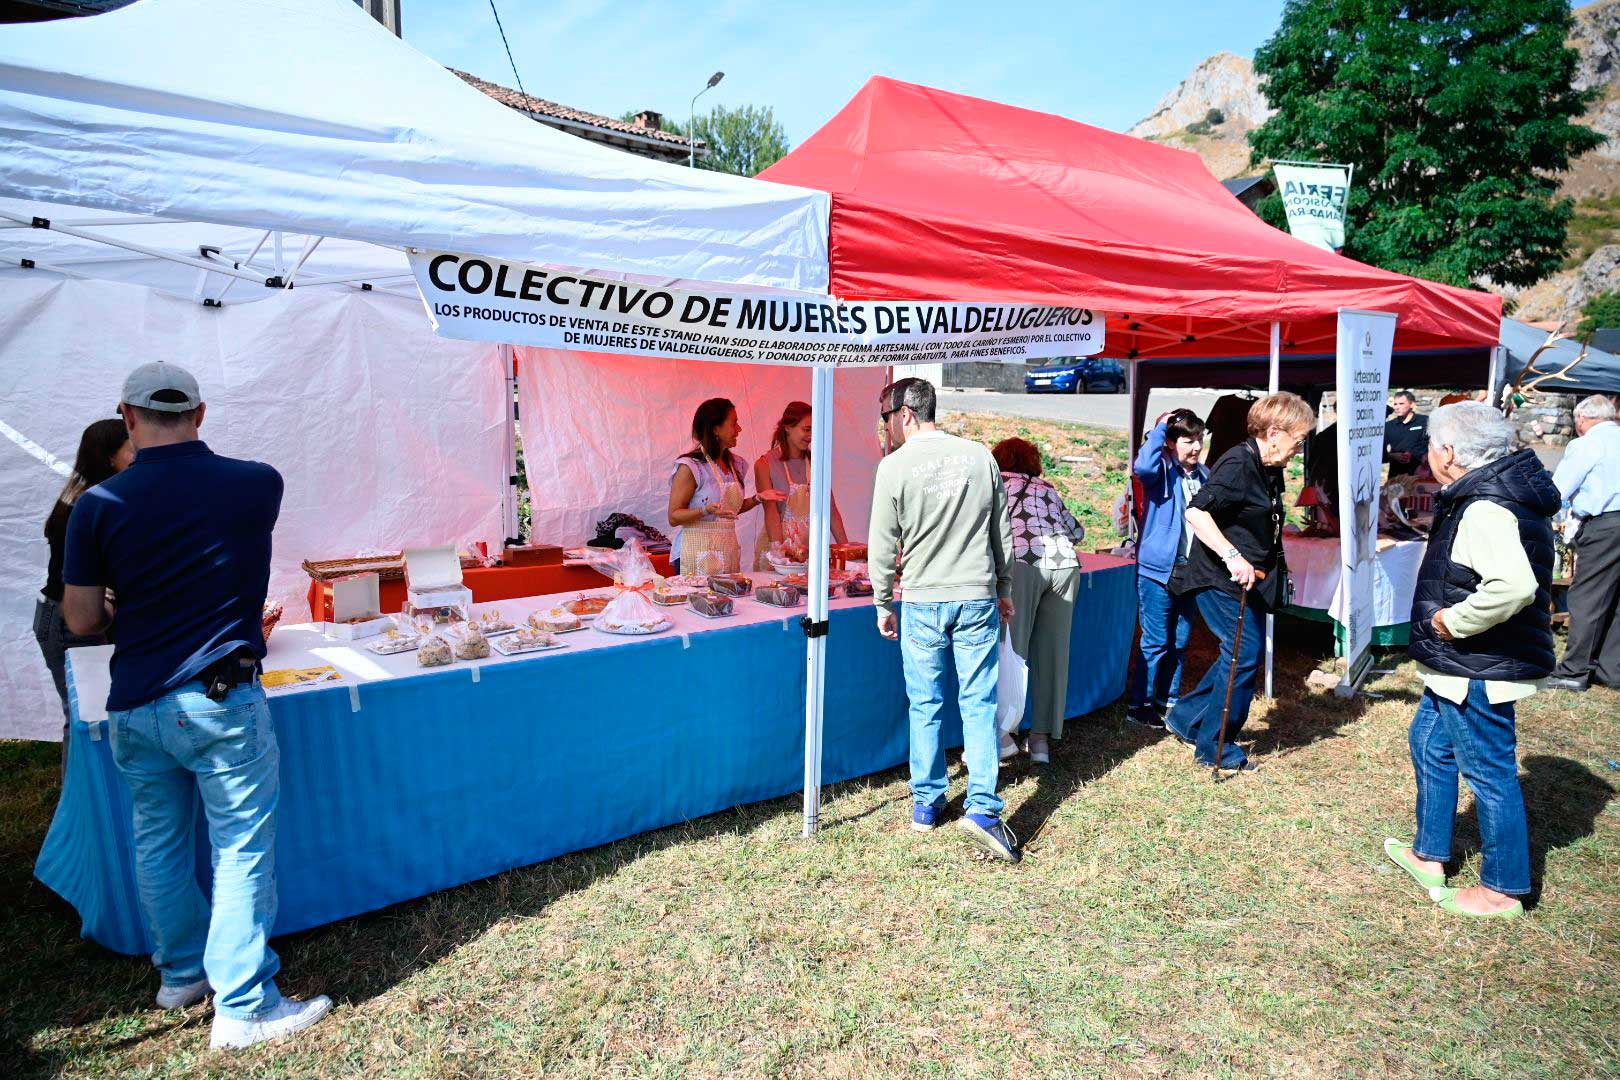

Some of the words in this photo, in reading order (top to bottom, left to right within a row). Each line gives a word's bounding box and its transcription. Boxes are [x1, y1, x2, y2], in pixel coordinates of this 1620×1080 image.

[429, 254, 674, 319] COLECTIVO
[680, 295, 732, 328] DE
[736, 298, 868, 335] MUJERES
[874, 306, 911, 335] DE
[915, 305, 1093, 334] VALDELUGUEROS
[434, 302, 461, 317] LOS
[463, 306, 546, 326] PRODUCTOS
[549, 315, 567, 328] DE
[569, 317, 609, 332] VENTA
[612, 322, 630, 334] DE
[631, 324, 661, 338] ESTE
[661, 328, 702, 343] STAND
[703, 334, 730, 347] HAN
[730, 337, 758, 348] SIDO
[758, 340, 827, 353] ELABORADOS
[826, 343, 841, 353] DE
[841, 343, 873, 353] FORMA
[873, 342, 920, 353] ARTESANAL
[943, 340, 963, 350] TODO
[963, 340, 971, 348] EL
[998, 336, 1003, 346] Y
[1030, 334, 1044, 343] POR
[1045, 333, 1052, 342] EL
[1053, 332, 1091, 342] COLECTIVO
[564, 331, 581, 343] DE
[583, 333, 637, 349] MUJERES
[640, 338, 657, 351] DE
[658, 340, 755, 361] VALDELUGUEROS,
[758, 350, 765, 360] Y
[766, 351, 817, 362] DONADOS
[817, 353, 837, 363] POR
[838, 354, 866, 364] ELLAS,
[868, 354, 880, 363] DE
[880, 353, 910, 362] FORMA
[950, 350, 969, 359] PARA
[969, 347, 989, 357] FINES
